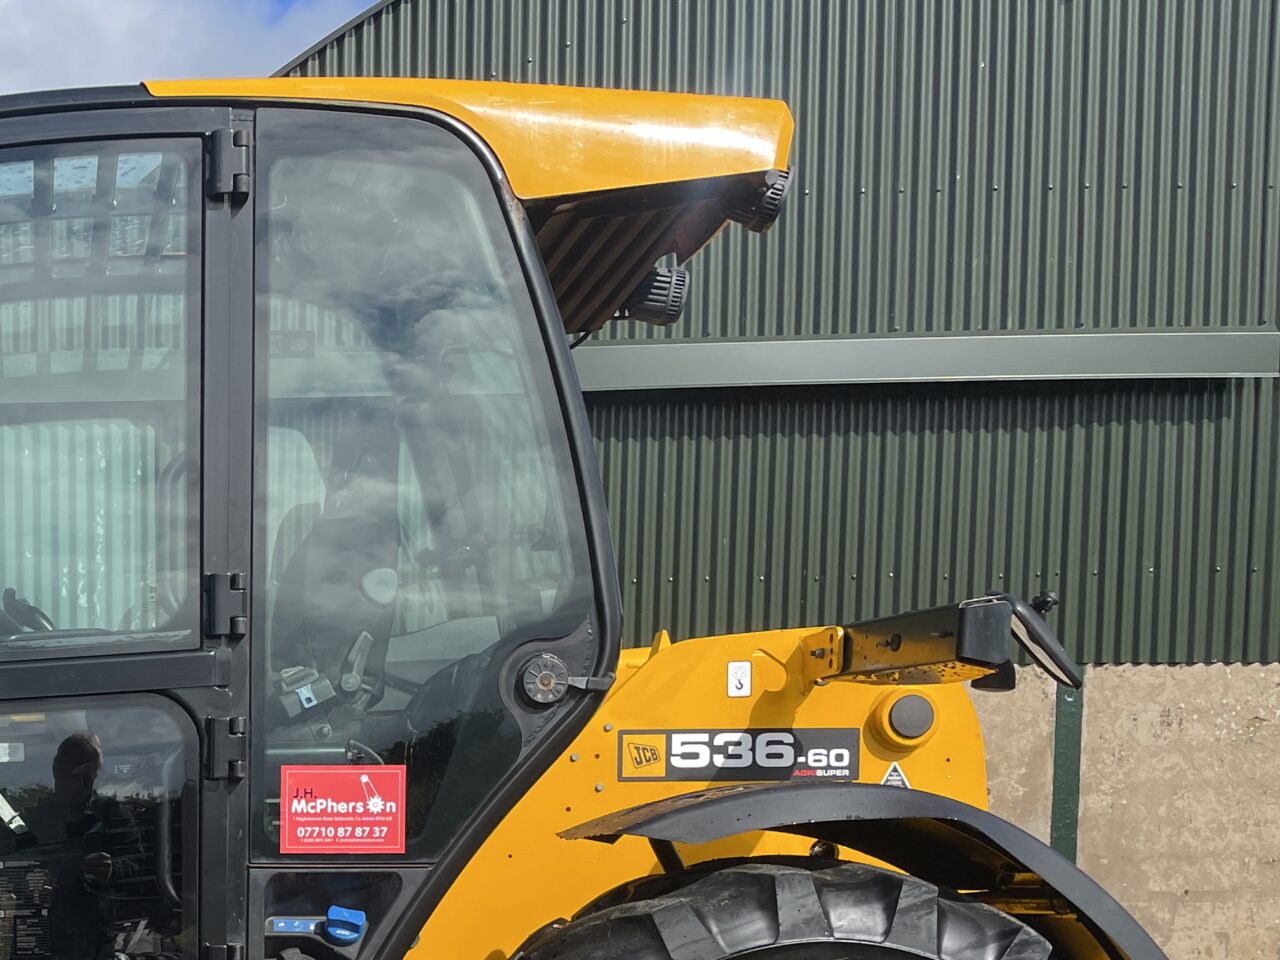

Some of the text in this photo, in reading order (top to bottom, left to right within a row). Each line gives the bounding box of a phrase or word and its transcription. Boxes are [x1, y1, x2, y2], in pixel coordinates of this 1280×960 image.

[633, 745, 658, 765] JCB
[293, 788, 317, 799] J.H.
[297, 826, 388, 837] 07710 87 87 37
